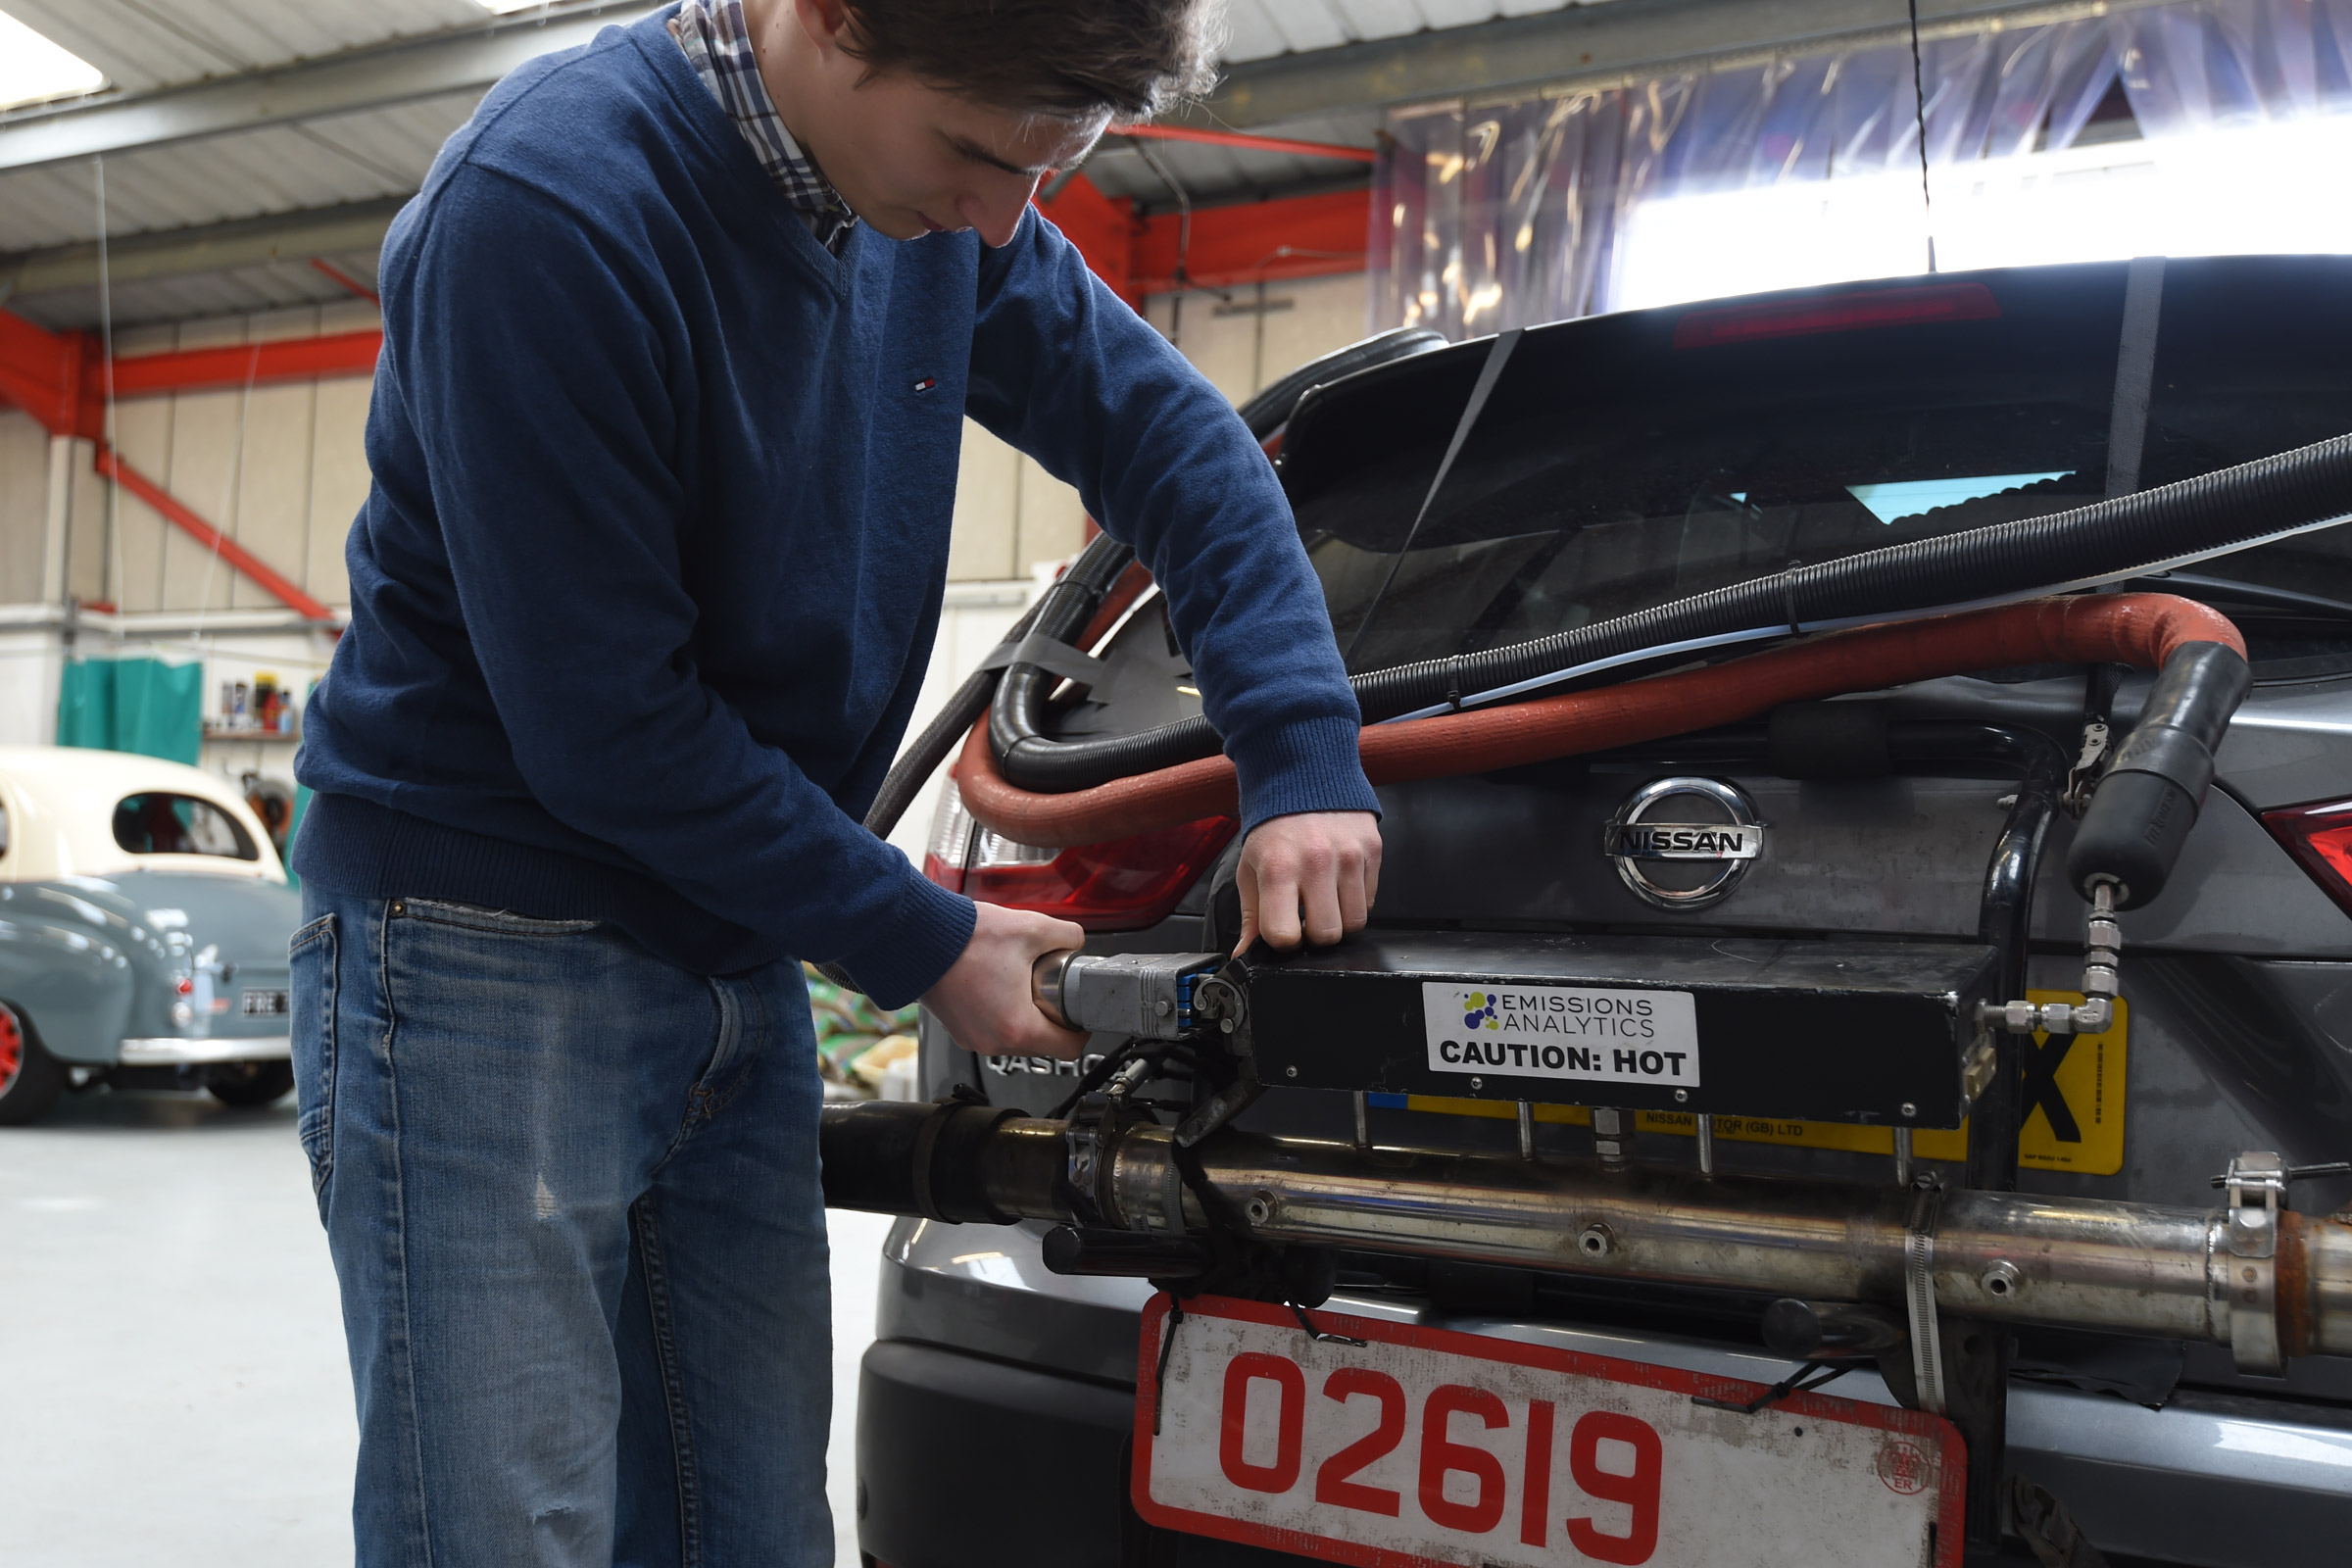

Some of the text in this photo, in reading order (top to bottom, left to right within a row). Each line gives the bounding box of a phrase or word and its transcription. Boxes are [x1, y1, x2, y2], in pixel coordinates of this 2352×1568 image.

[1619, 831, 1743, 853] NISSAN
[1502, 995, 1653, 1016] EMISSIONS
[1504, 1013, 1654, 1038] ANALYTICS
[1440, 1041, 1687, 1076] CAUTION: HOT
[1646, 1112, 1691, 1126] NISSAN
[1745, 1121, 1774, 1136] (GB)
[1778, 1124, 1803, 1137] LTD
[1218, 1351, 1663, 1566] 02619
